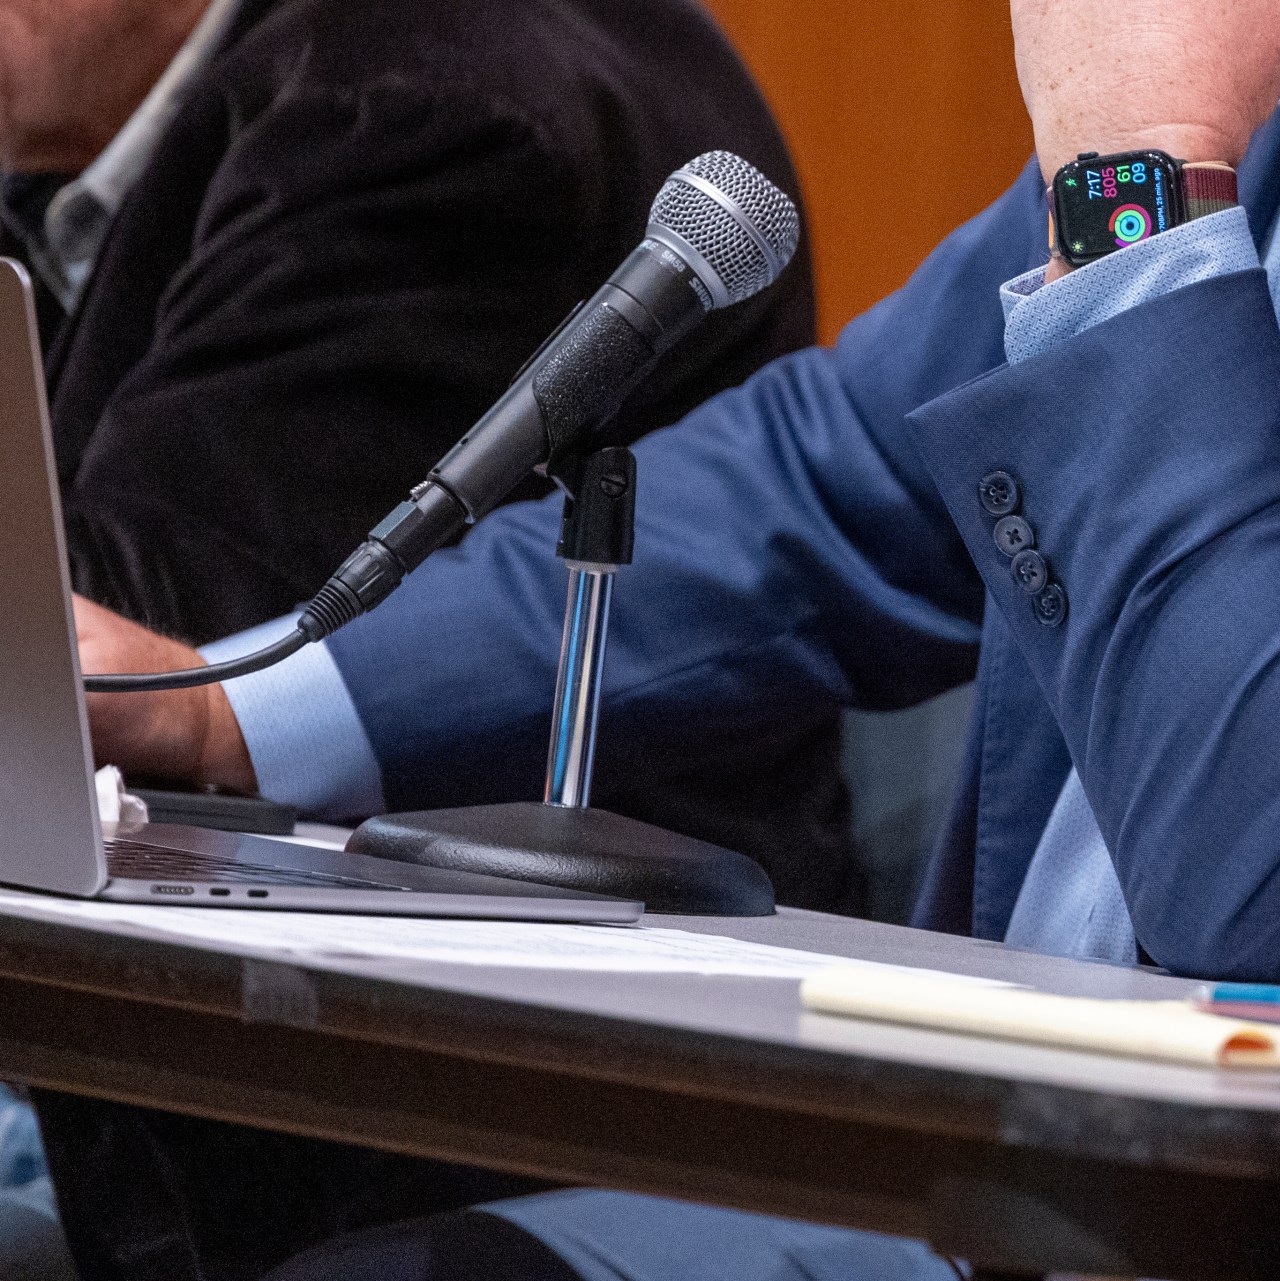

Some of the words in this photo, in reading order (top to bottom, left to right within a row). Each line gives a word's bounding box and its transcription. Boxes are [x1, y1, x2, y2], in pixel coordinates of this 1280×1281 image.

[1101, 167, 1117, 198] 805
[1116, 165, 1131, 182] 61
[1131, 162, 1146, 183] 09
[1086, 170, 1102, 199] 7:17
[661, 250, 686, 272] SM58
